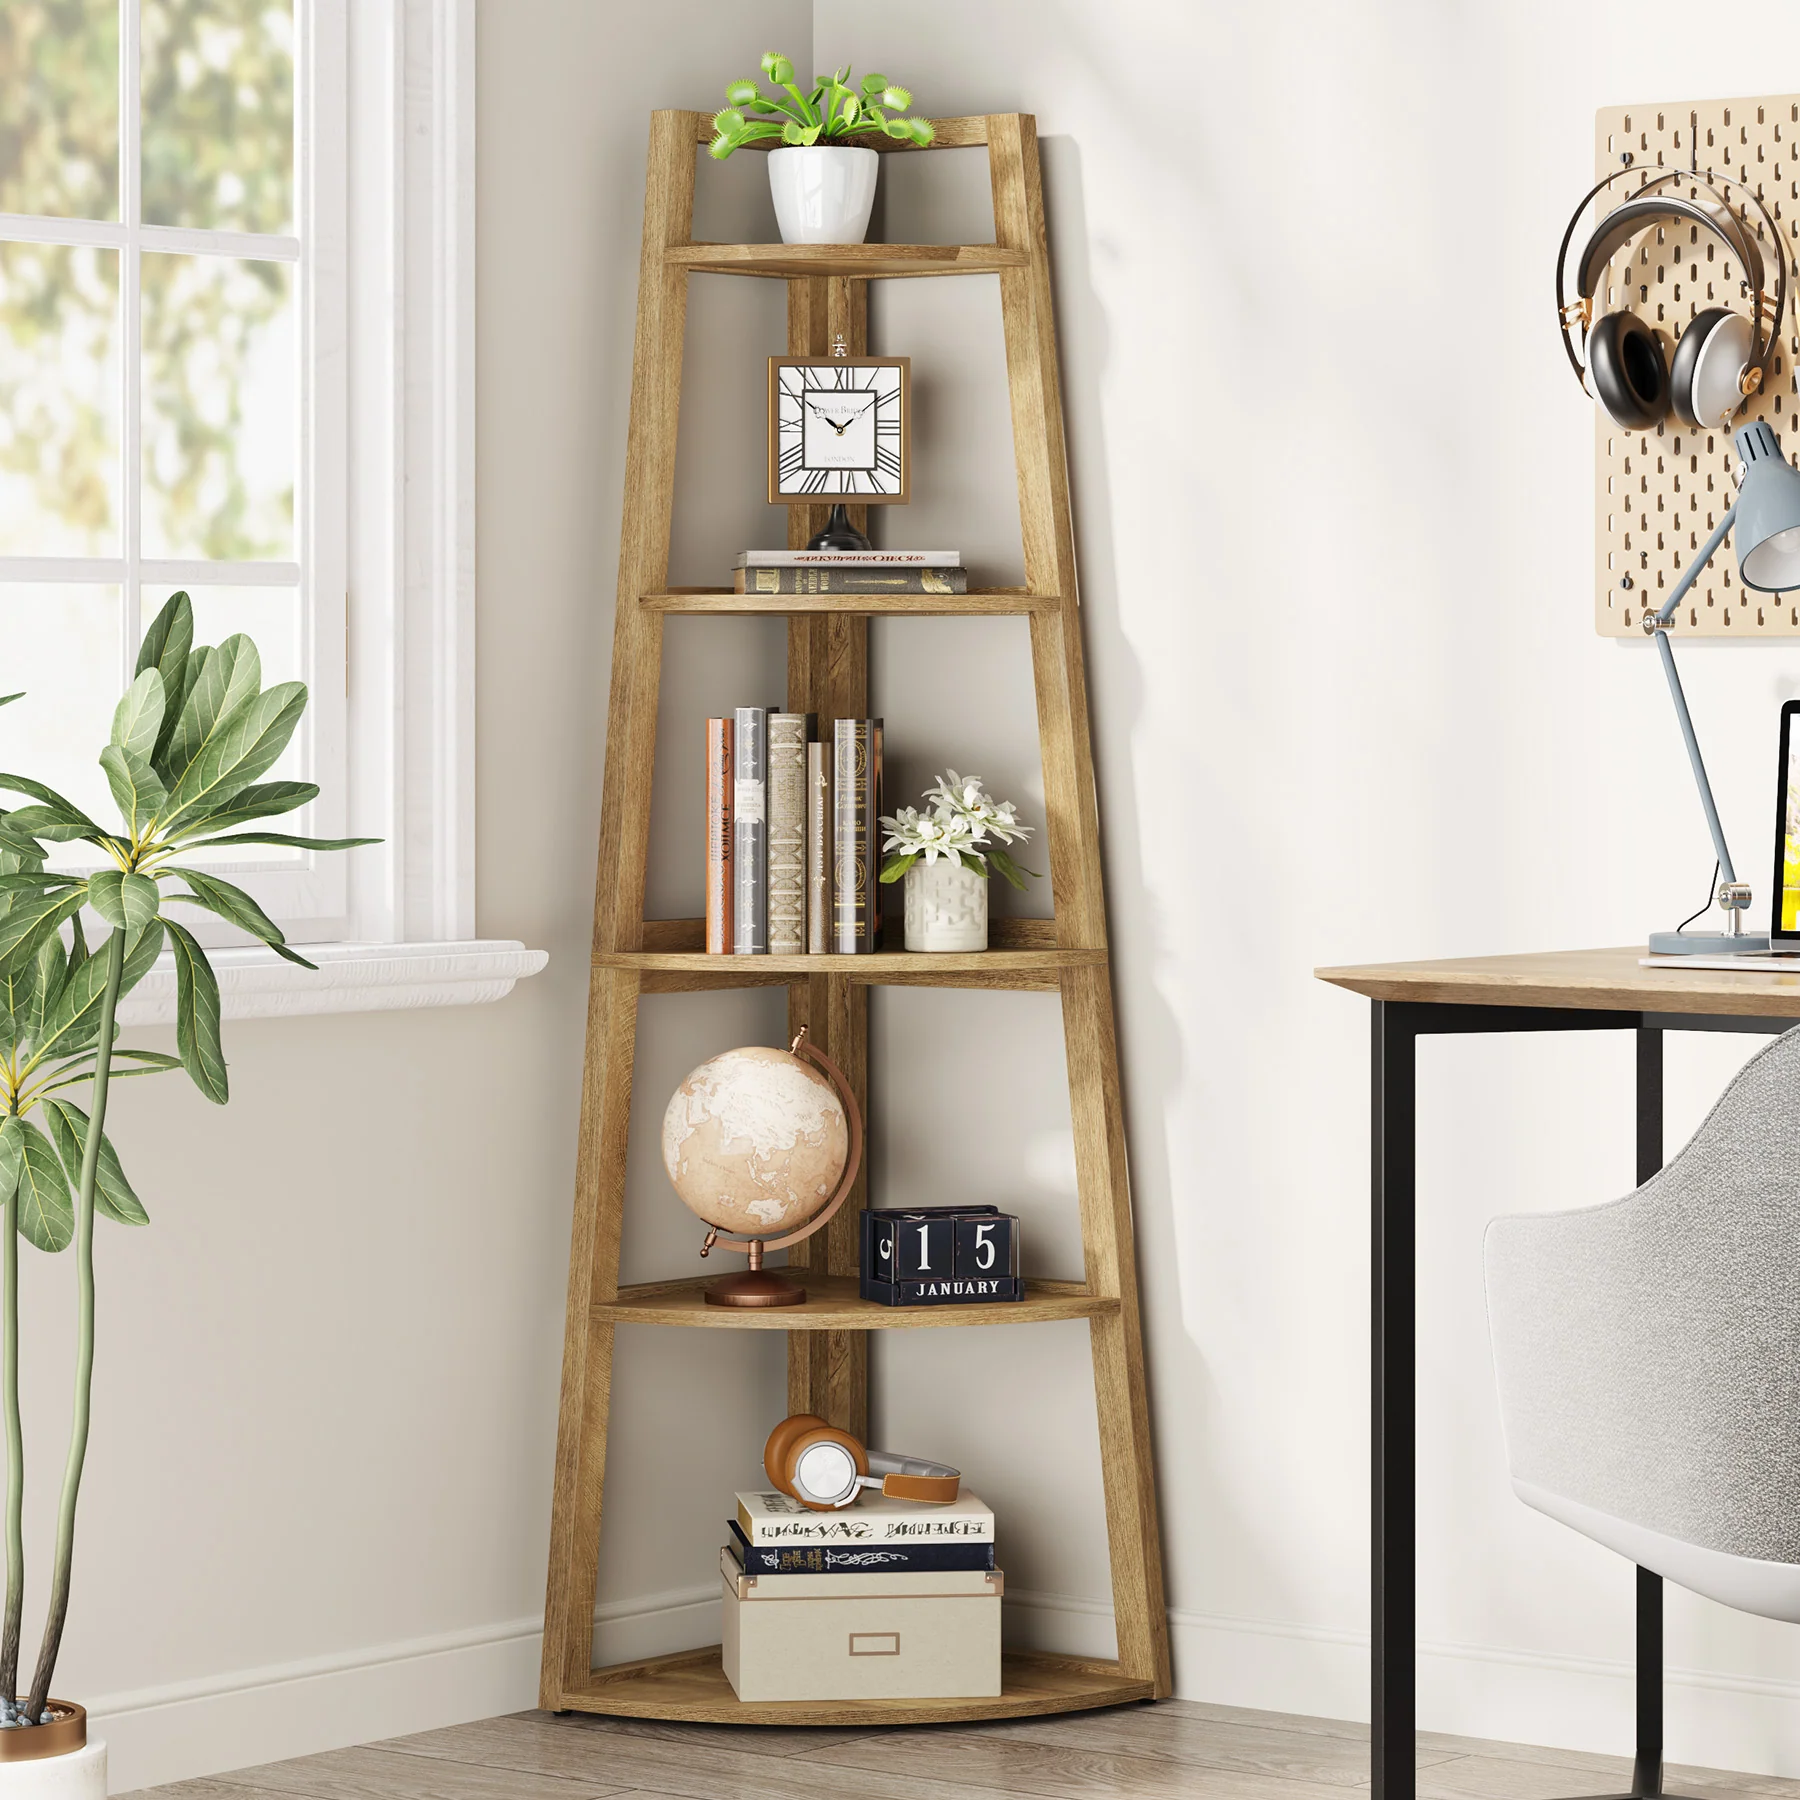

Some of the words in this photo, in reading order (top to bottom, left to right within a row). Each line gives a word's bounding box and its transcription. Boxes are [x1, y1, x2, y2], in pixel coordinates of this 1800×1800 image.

[916, 1224, 932, 1270] 1
[975, 1224, 996, 1270] 5
[916, 1280, 1000, 1297] JANUARY
